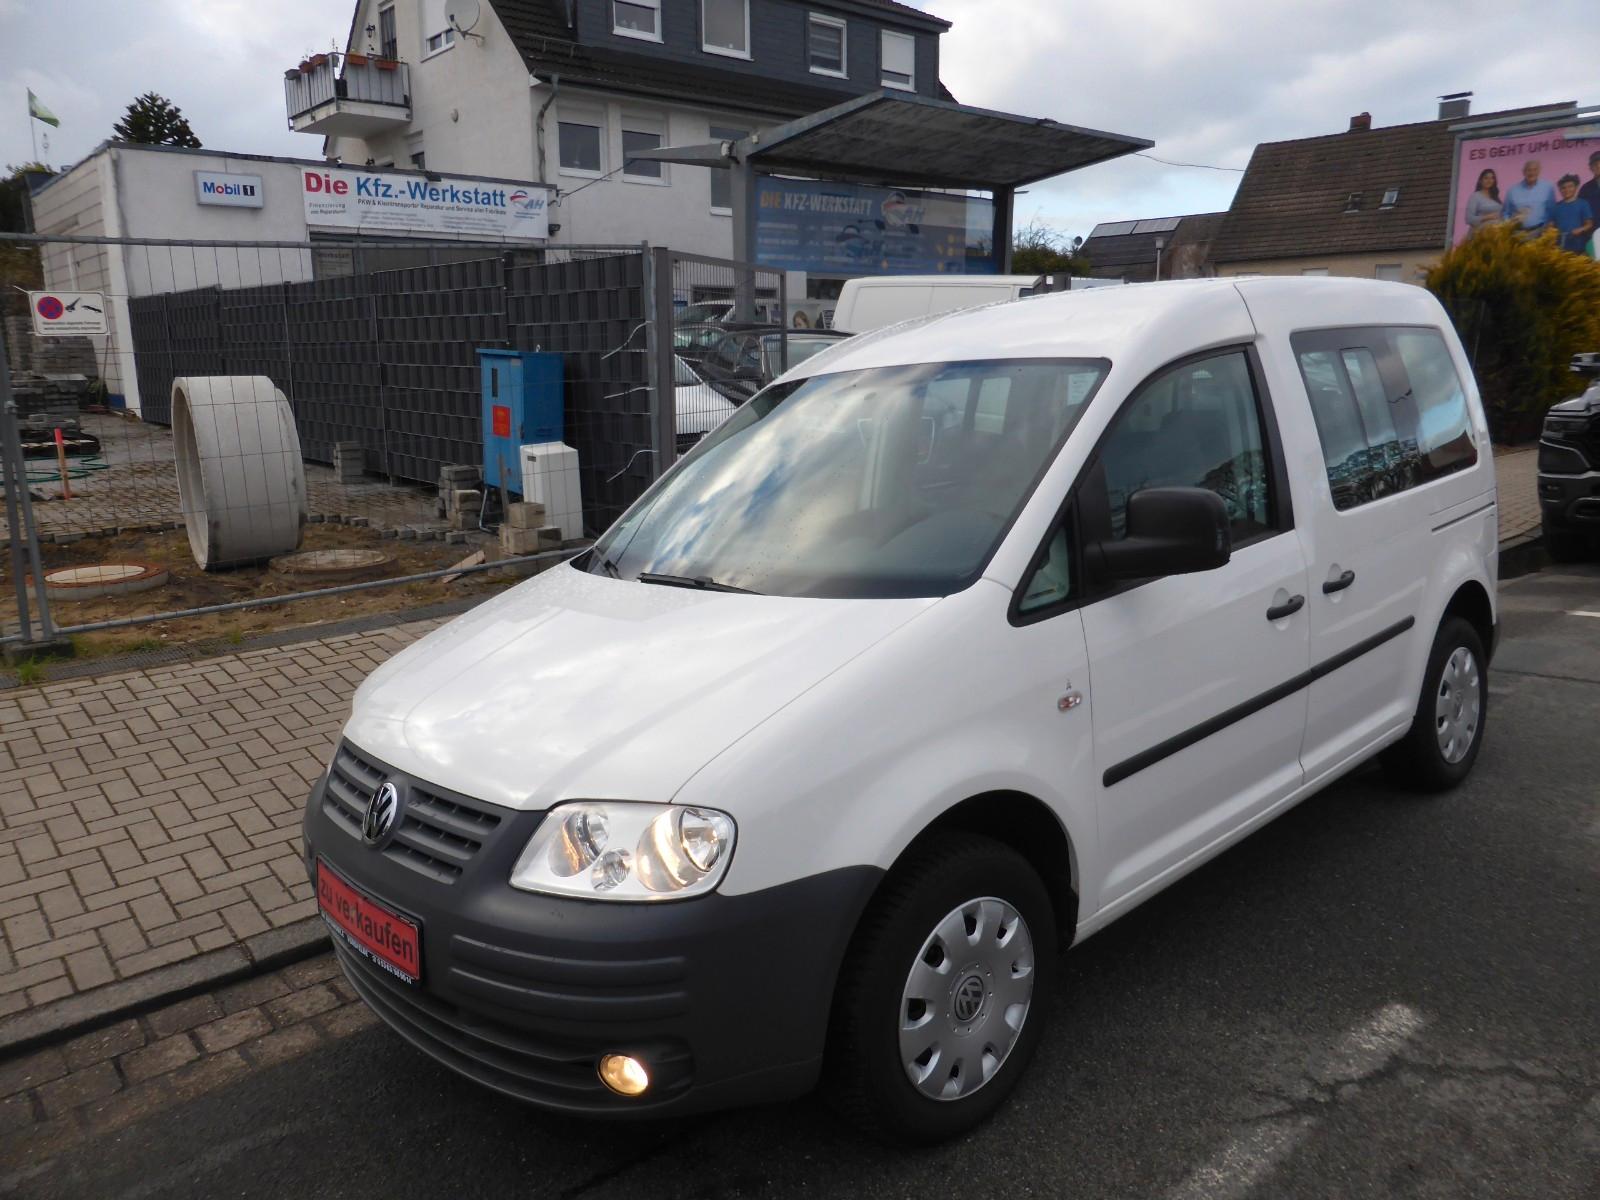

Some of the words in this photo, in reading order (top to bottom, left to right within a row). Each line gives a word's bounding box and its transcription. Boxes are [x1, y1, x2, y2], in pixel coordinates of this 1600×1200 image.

[1469, 148, 1486, 160] ES
[1489, 143, 1525, 158] GEHT
[1528, 141, 1549, 153] UM
[203, 182, 240, 195] Mobil
[305, 172, 349, 195] Die
[356, 176, 506, 207] Kfz.-Werkstatt
[760, 191, 782, 209] DIE
[784, 191, 873, 216] KFZ-WERKSTATT
[320, 878, 333, 905] zu
